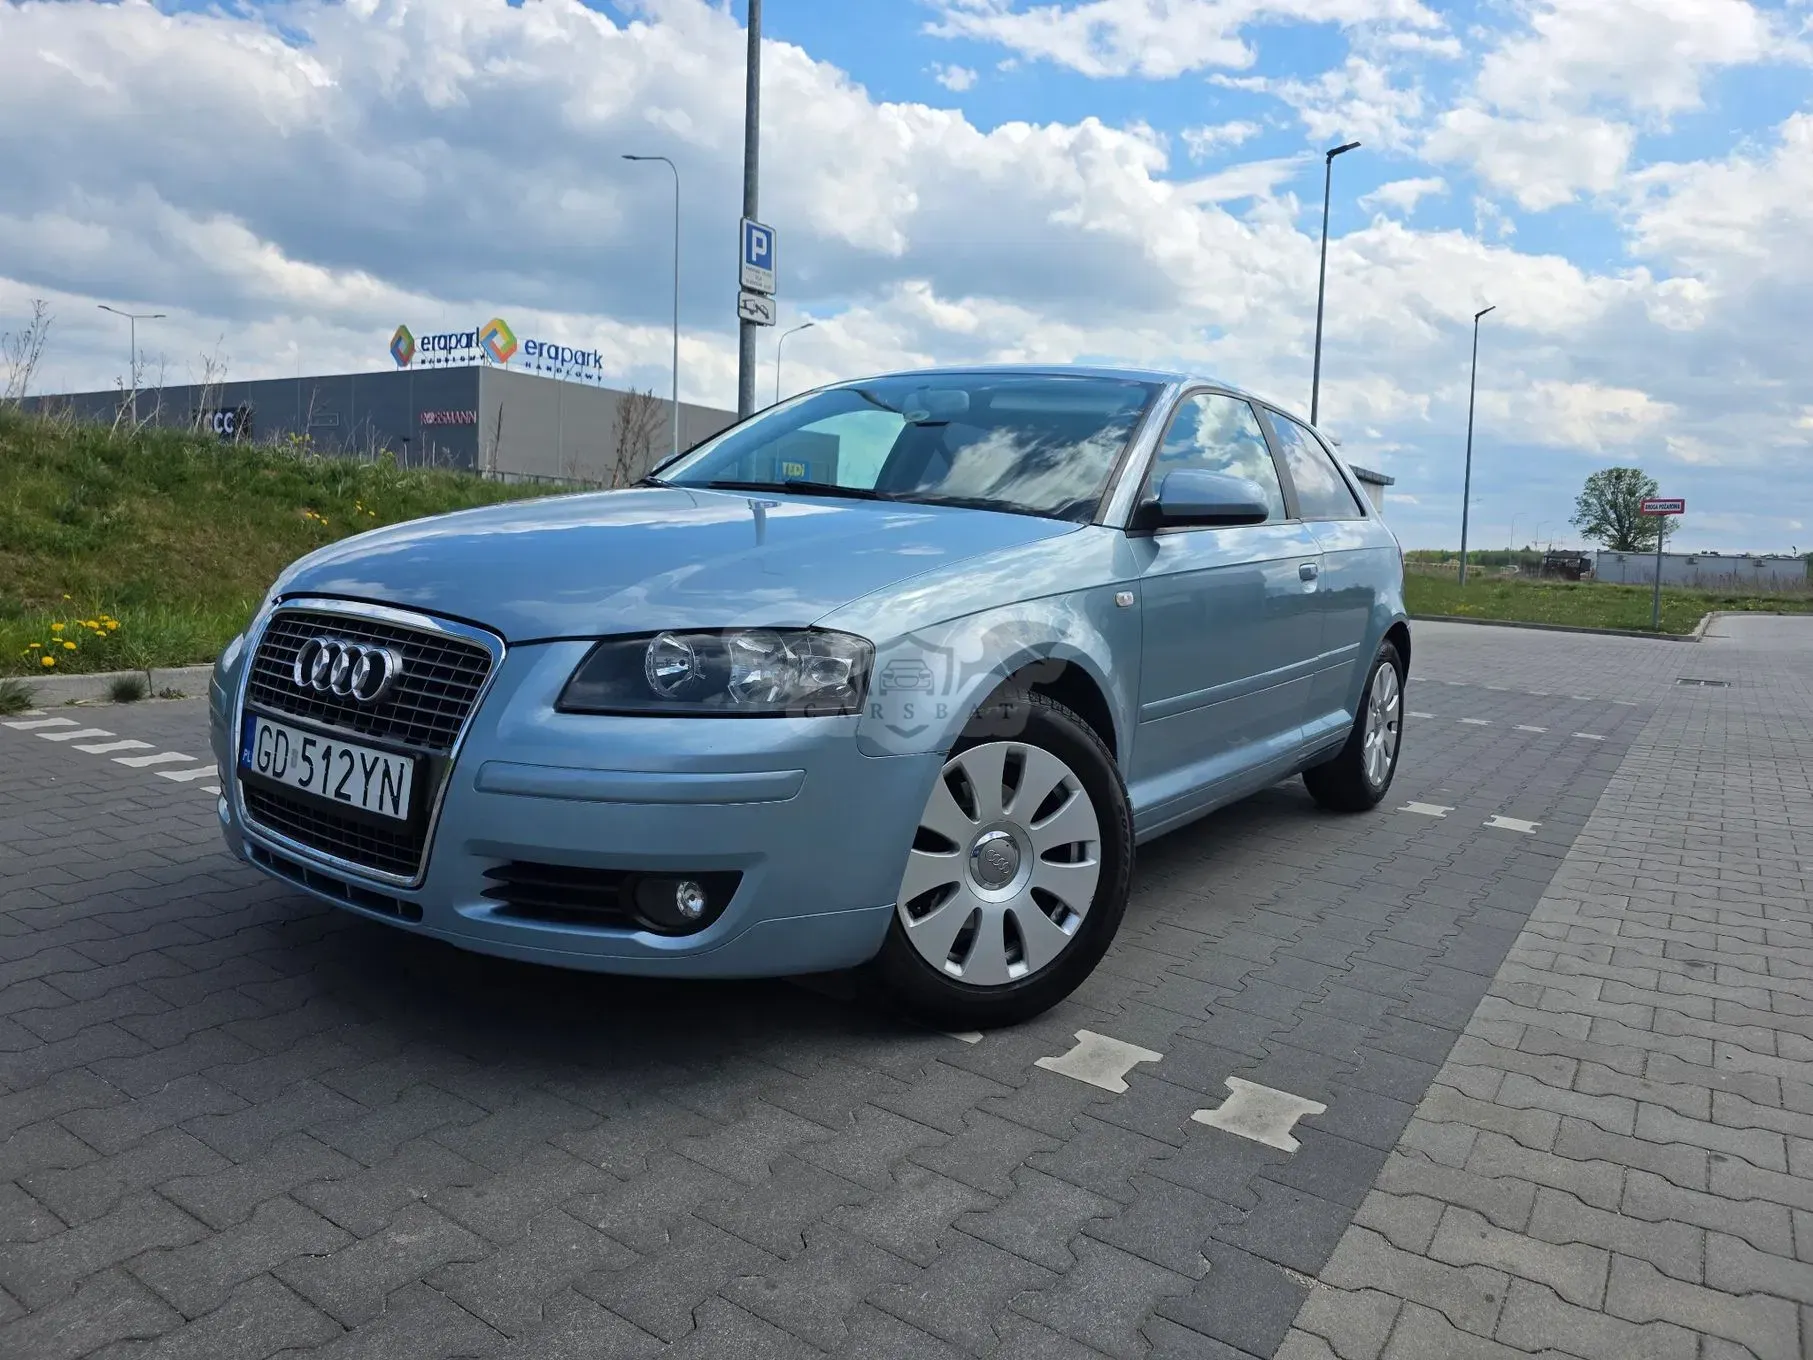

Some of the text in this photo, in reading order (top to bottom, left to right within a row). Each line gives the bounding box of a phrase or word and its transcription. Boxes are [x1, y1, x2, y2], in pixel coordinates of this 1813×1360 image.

[751, 228, 767, 261] P
[524, 339, 603, 369] erapark
[525, 361, 602, 382] HANDLOWY
[420, 411, 477, 425] ROSSMANN
[257, 724, 405, 815] GD 512YN
